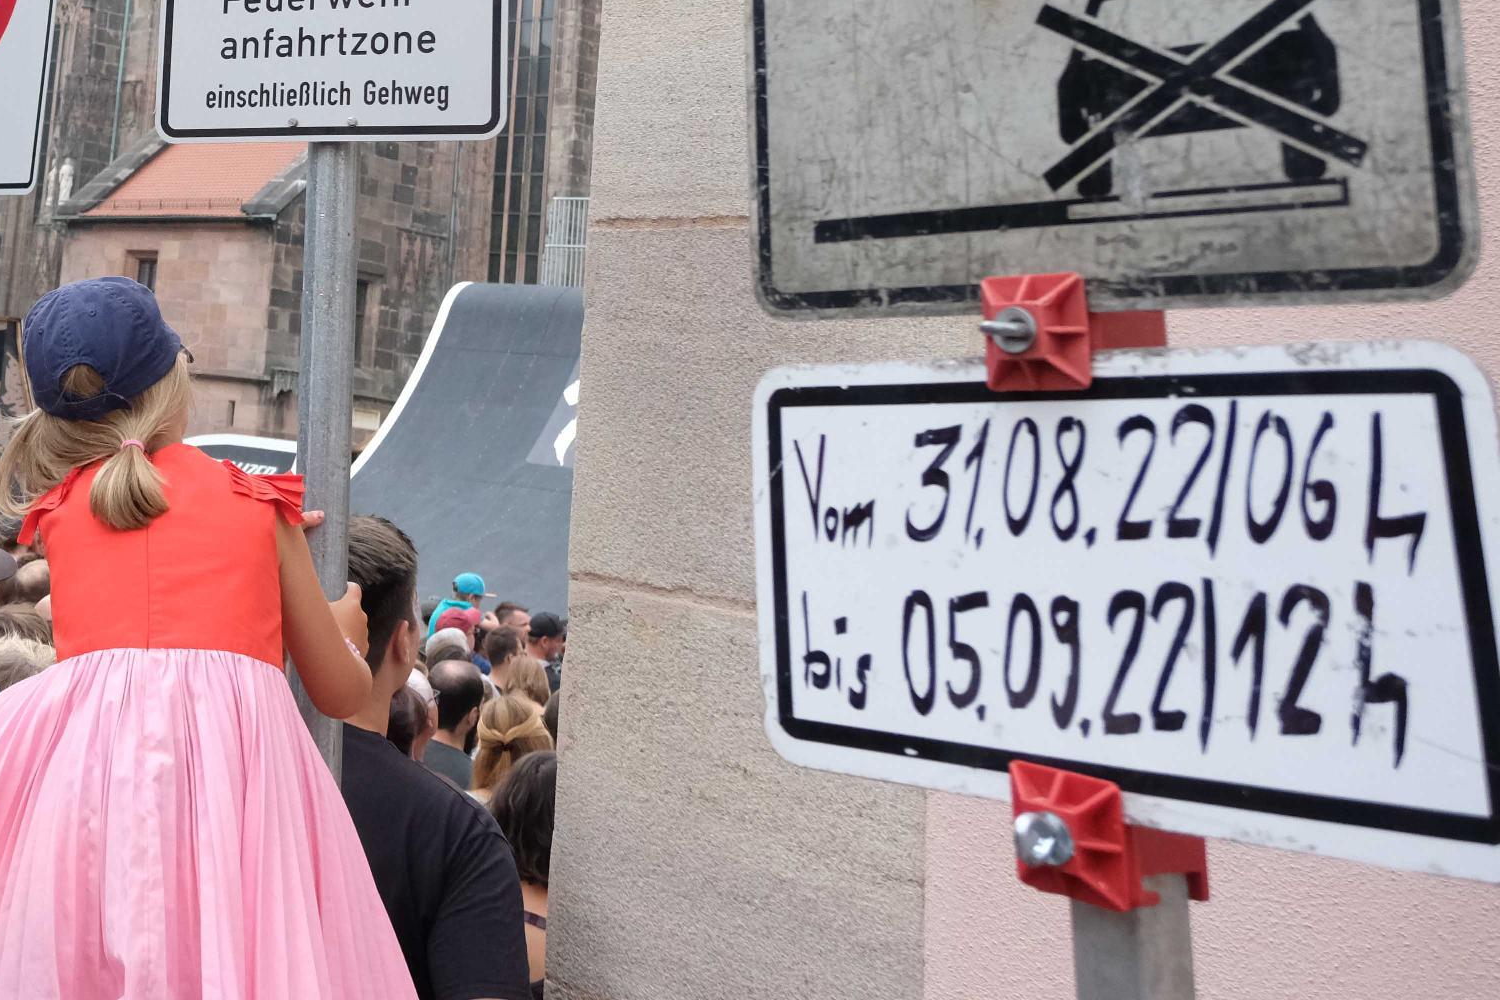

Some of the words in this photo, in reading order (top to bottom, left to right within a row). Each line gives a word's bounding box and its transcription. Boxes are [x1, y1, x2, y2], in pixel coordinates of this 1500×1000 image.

[220, 26, 437, 60] anfahrtzone
[205, 81, 351, 109] einschließlich
[363, 79, 450, 111] Gehweg
[793, 434, 876, 549] Vom
[802, 590, 872, 711] bis
[1351, 581, 1409, 769] h
